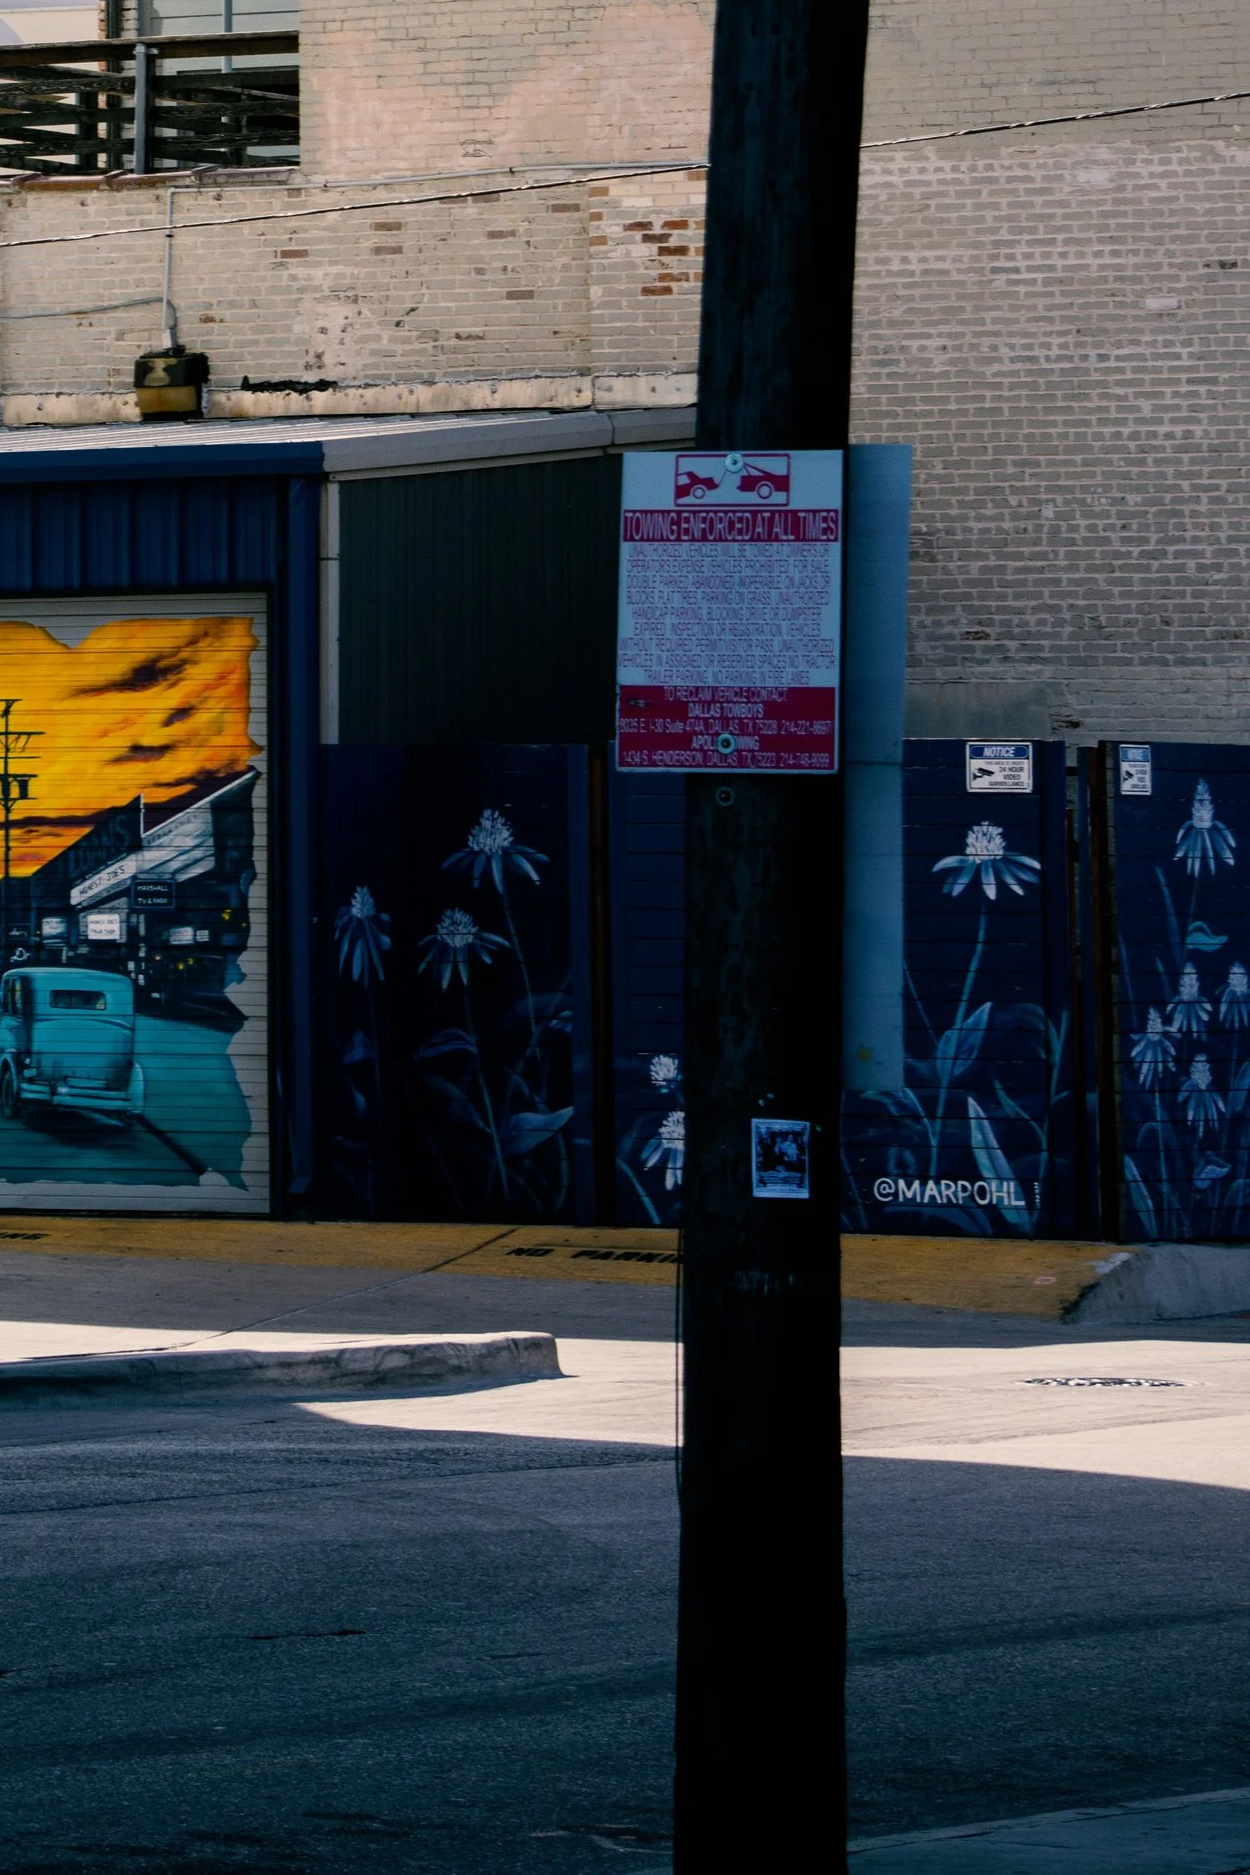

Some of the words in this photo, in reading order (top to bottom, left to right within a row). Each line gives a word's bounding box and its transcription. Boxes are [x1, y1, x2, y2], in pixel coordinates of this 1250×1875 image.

[625, 512, 677, 541] TOWING
[681, 512, 752, 541] ENFORCED
[754, 512, 770, 541] AT
[772, 512, 795, 541] ALL
[798, 512, 836, 541] TIMES
[663, 687, 675, 701] TO
[676, 687, 712, 701] RECLAIM
[713, 688, 748, 701] VEHICLE
[688, 704, 721, 717] DALLAS
[742, 719, 754, 733] TX
[691, 735, 717, 750] APOLL
[982, 747, 1016, 757] NOTICE
[873, 1177, 1026, 1206] @MARPOHL
[505, 1247, 555, 1257] NO
[570, 1250, 682, 1263] PARKI
